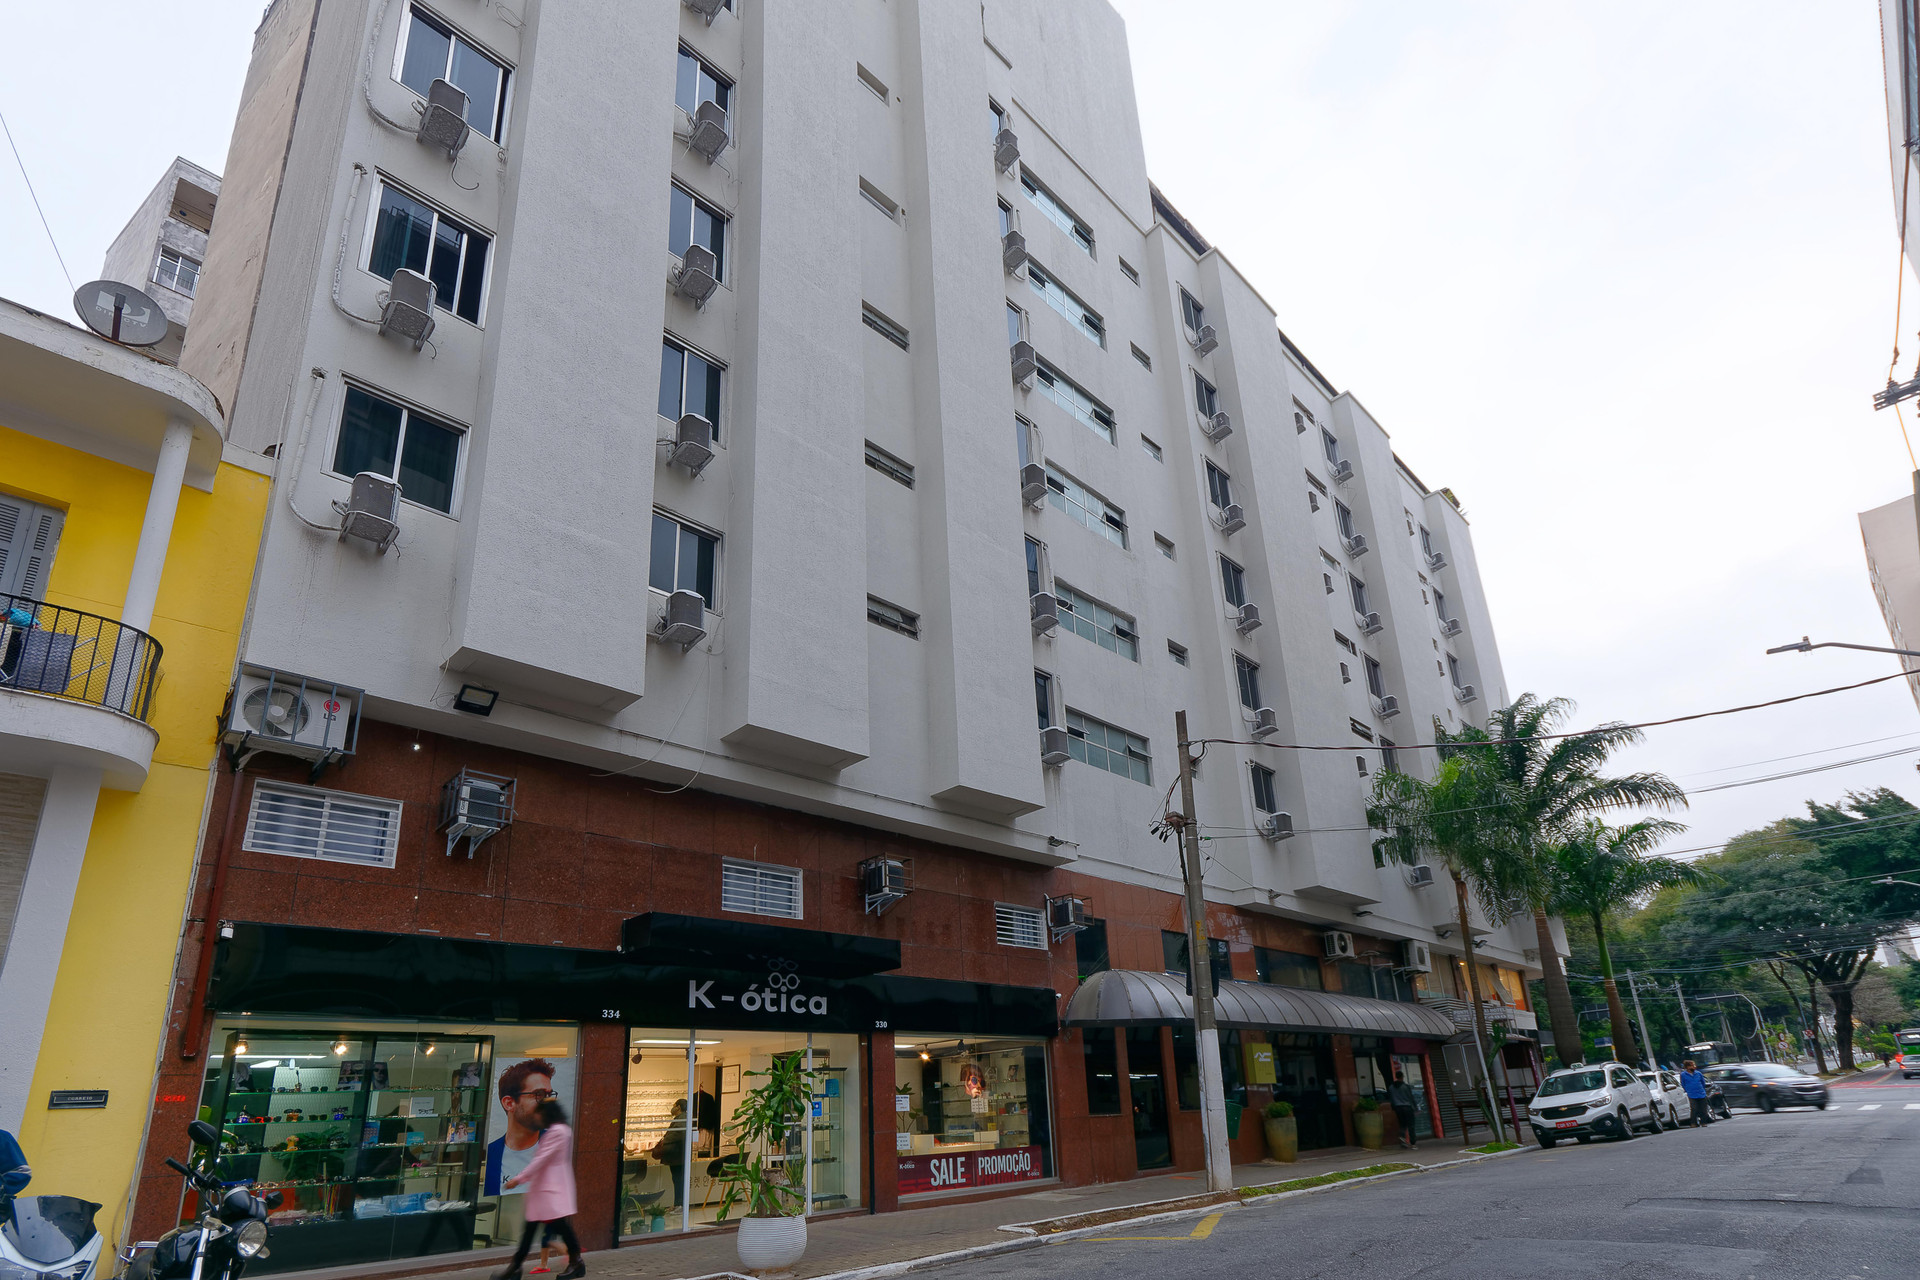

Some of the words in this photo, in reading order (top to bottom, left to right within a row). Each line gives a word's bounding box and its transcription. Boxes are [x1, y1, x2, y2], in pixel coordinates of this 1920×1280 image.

[95, 305, 146, 327] DIRCTV
[602, 1009, 620, 1019] 334
[875, 1020, 888, 1028] 330
[930, 1156, 966, 1187] SALE
[978, 1150, 1031, 1176] PROMOÇÃO
